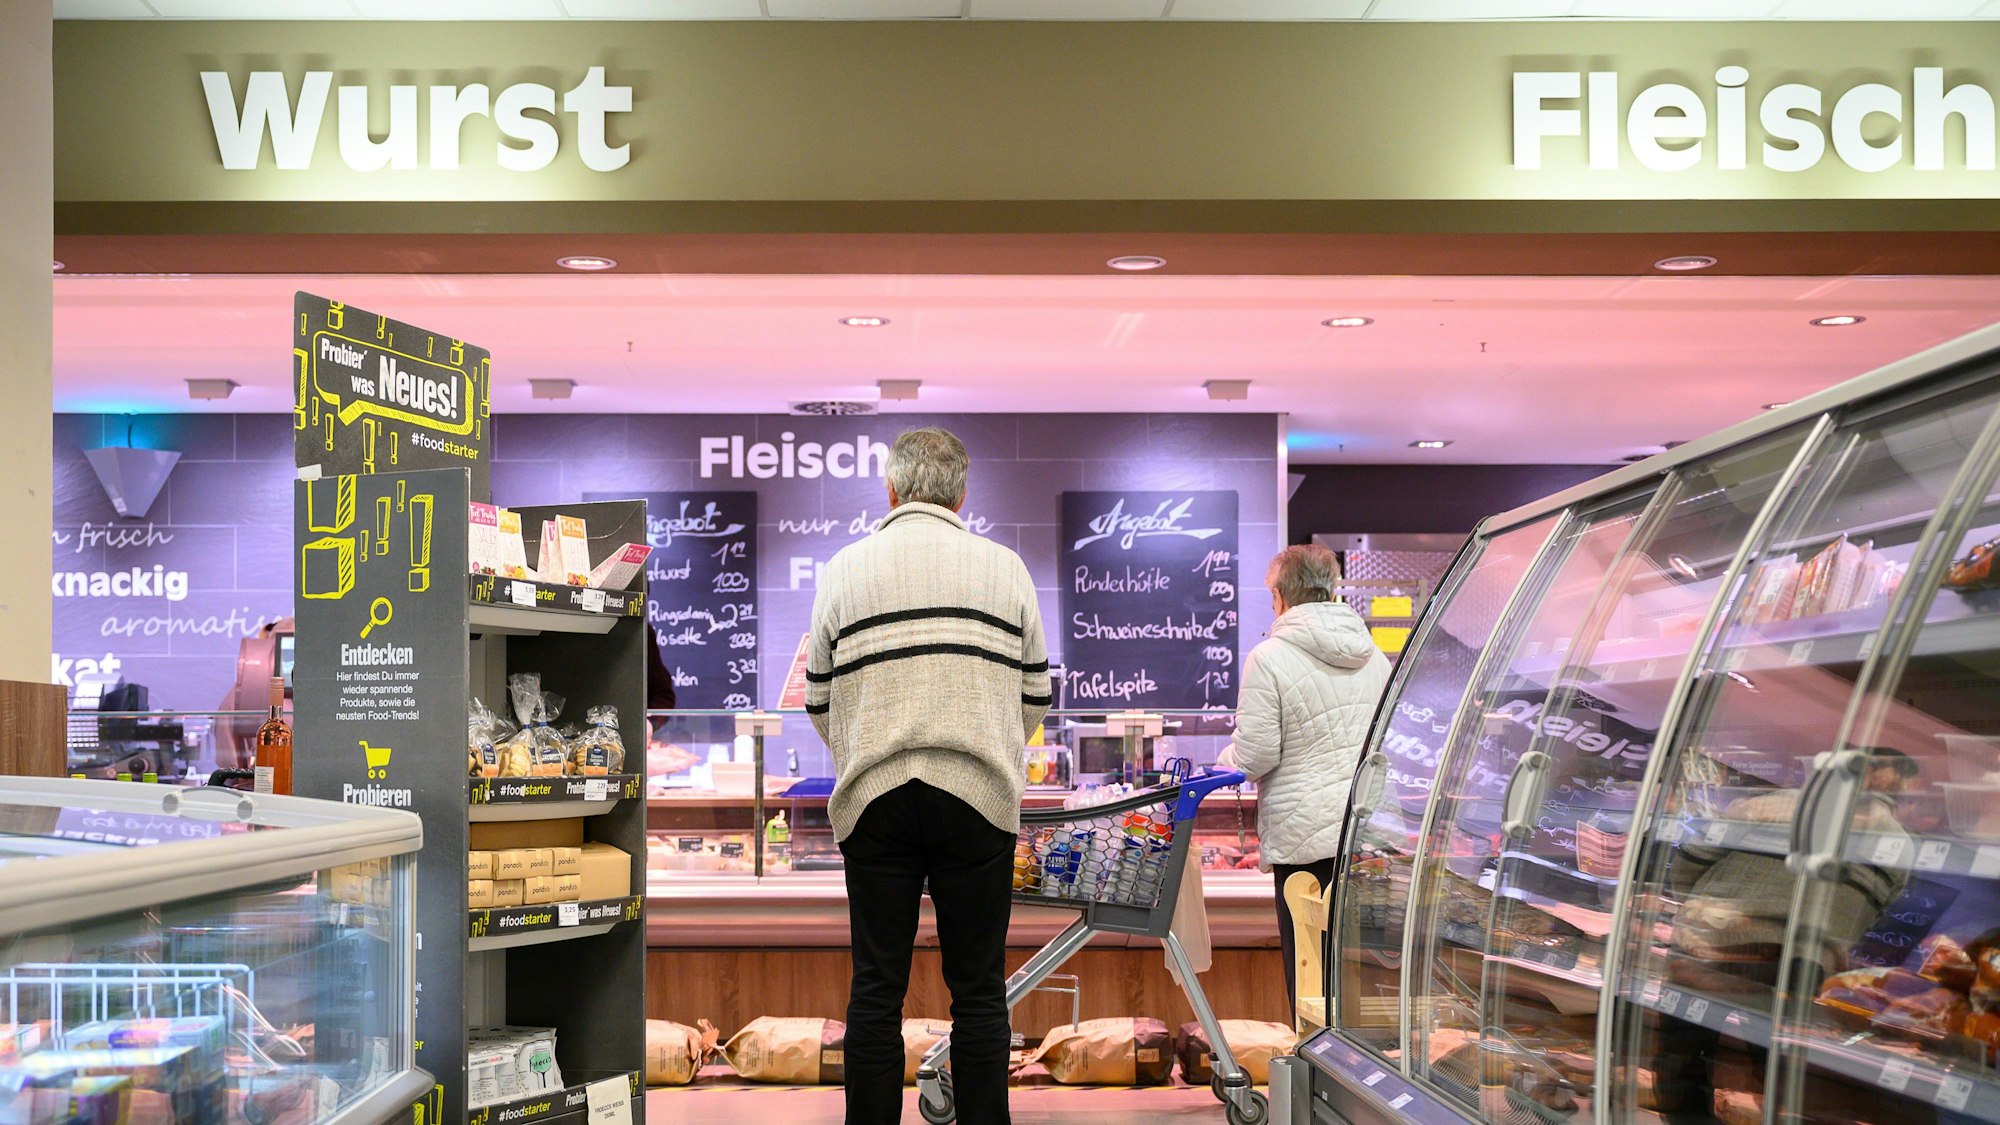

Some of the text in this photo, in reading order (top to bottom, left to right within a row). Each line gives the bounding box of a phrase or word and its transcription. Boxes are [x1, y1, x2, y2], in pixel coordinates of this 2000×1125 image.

[200, 66, 633, 172] Wurst
[1512, 66, 1996, 173] Fleisch
[351, 355, 458, 419] was Neues!
[411, 432, 479, 460] #foodstarter
[700, 431, 889, 479] Fleisch
[647, 500, 722, 548] ngebot
[779, 517, 839, 536] nur
[1088, 498, 1195, 549] Angebot
[75, 521, 174, 554] frisch
[712, 572, 749, 593] 100g
[1209, 581, 1234, 602] 100g
[341, 643, 414, 666] Entdecken
[1202, 646, 1233, 667] 100g
[336, 671, 420, 682] Hier findest Du immer
[1067, 668, 1158, 701] Tafelspitz
[342, 684, 413, 696] wieder spannende
[340, 697, 416, 708] Produkte, sowie die
[336, 710, 420, 721] neusten Food-Trends!
[343, 783, 412, 807] Probieren
[499, 912, 552, 928] #foodstarter
[499, 1091, 587, 1122] #foodstarter Probier
